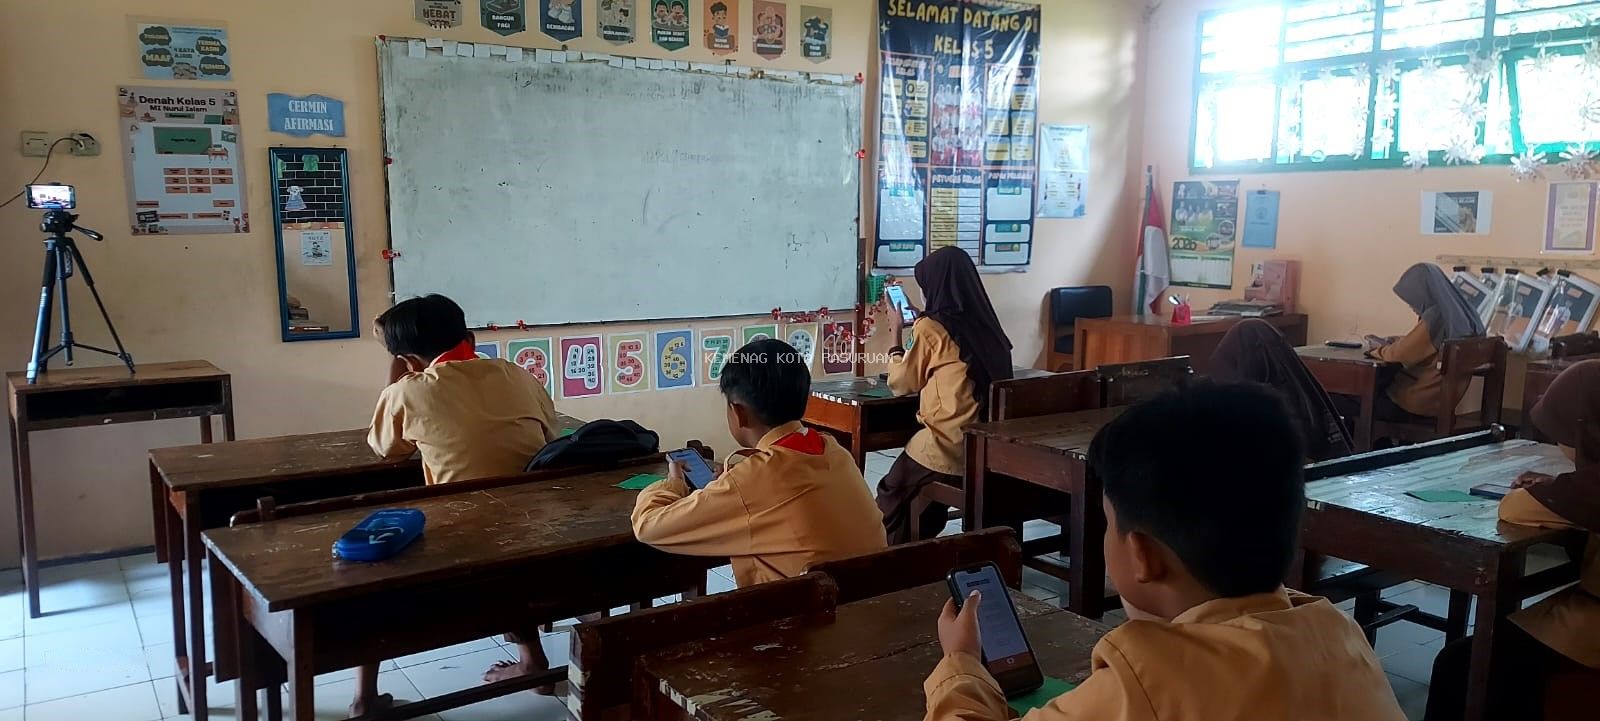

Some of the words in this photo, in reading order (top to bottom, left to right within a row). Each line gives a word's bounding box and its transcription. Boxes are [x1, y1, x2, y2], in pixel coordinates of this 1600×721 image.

[423, 8, 456, 19] HEBAT
[887, 0, 959, 24] SELAMAT
[963, 8, 1020, 32] DATANG
[1024, 16, 1038, 33] DI
[934, 34, 979, 59] KELS
[984, 38, 994, 59] 5
[145, 54, 171, 62] MAAF
[139, 95, 174, 105] Denah
[177, 97, 206, 106] Kelas
[208, 98, 216, 106] 5
[288, 99, 327, 114] CERMIN
[284, 117, 334, 131] AFIRMASI
